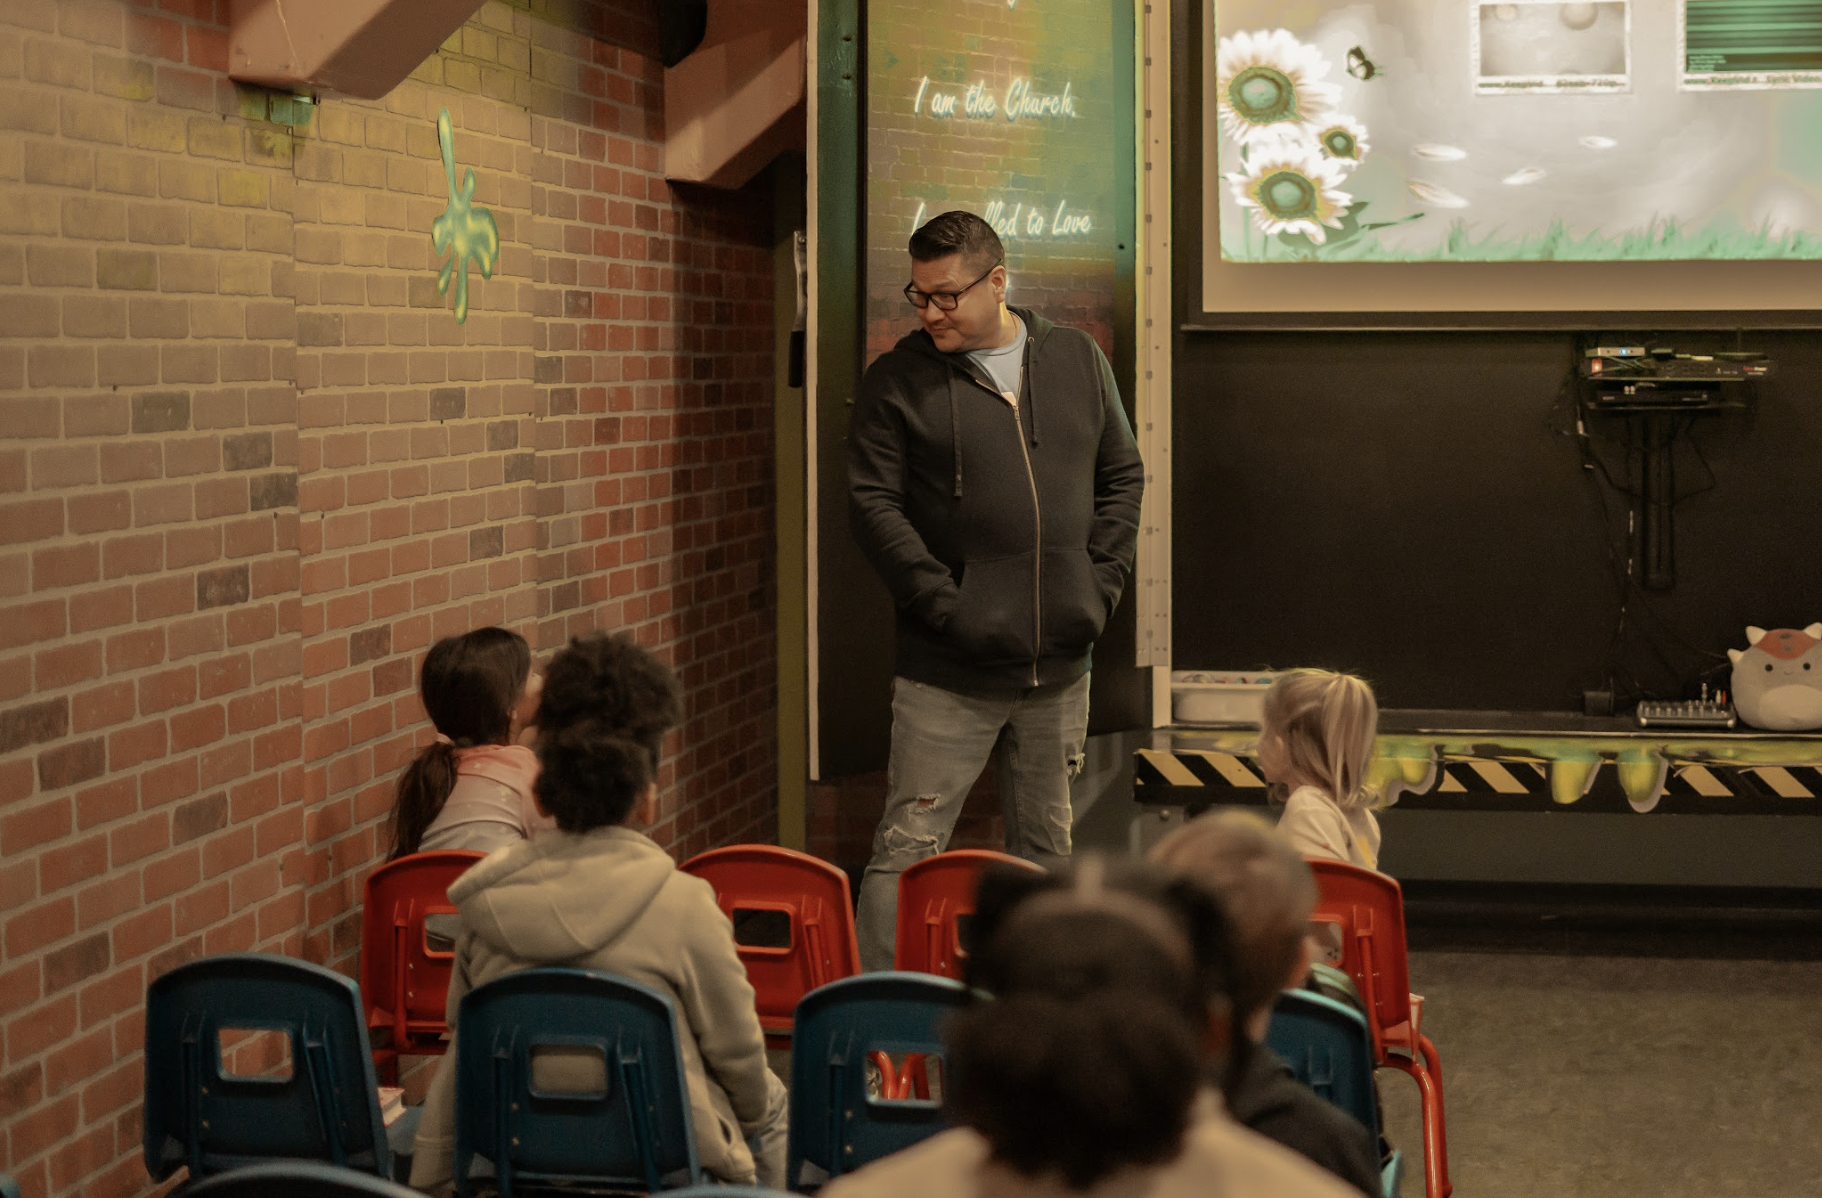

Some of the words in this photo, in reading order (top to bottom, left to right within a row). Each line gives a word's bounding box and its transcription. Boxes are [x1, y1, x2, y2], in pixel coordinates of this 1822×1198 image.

[914, 75, 929, 114] I
[931, 92, 956, 116] am
[965, 79, 996, 116] the
[1004, 76, 1077, 119] Church.
[984, 199, 1022, 237] lled
[1026, 206, 1045, 235] to
[1051, 199, 1092, 236] Love
